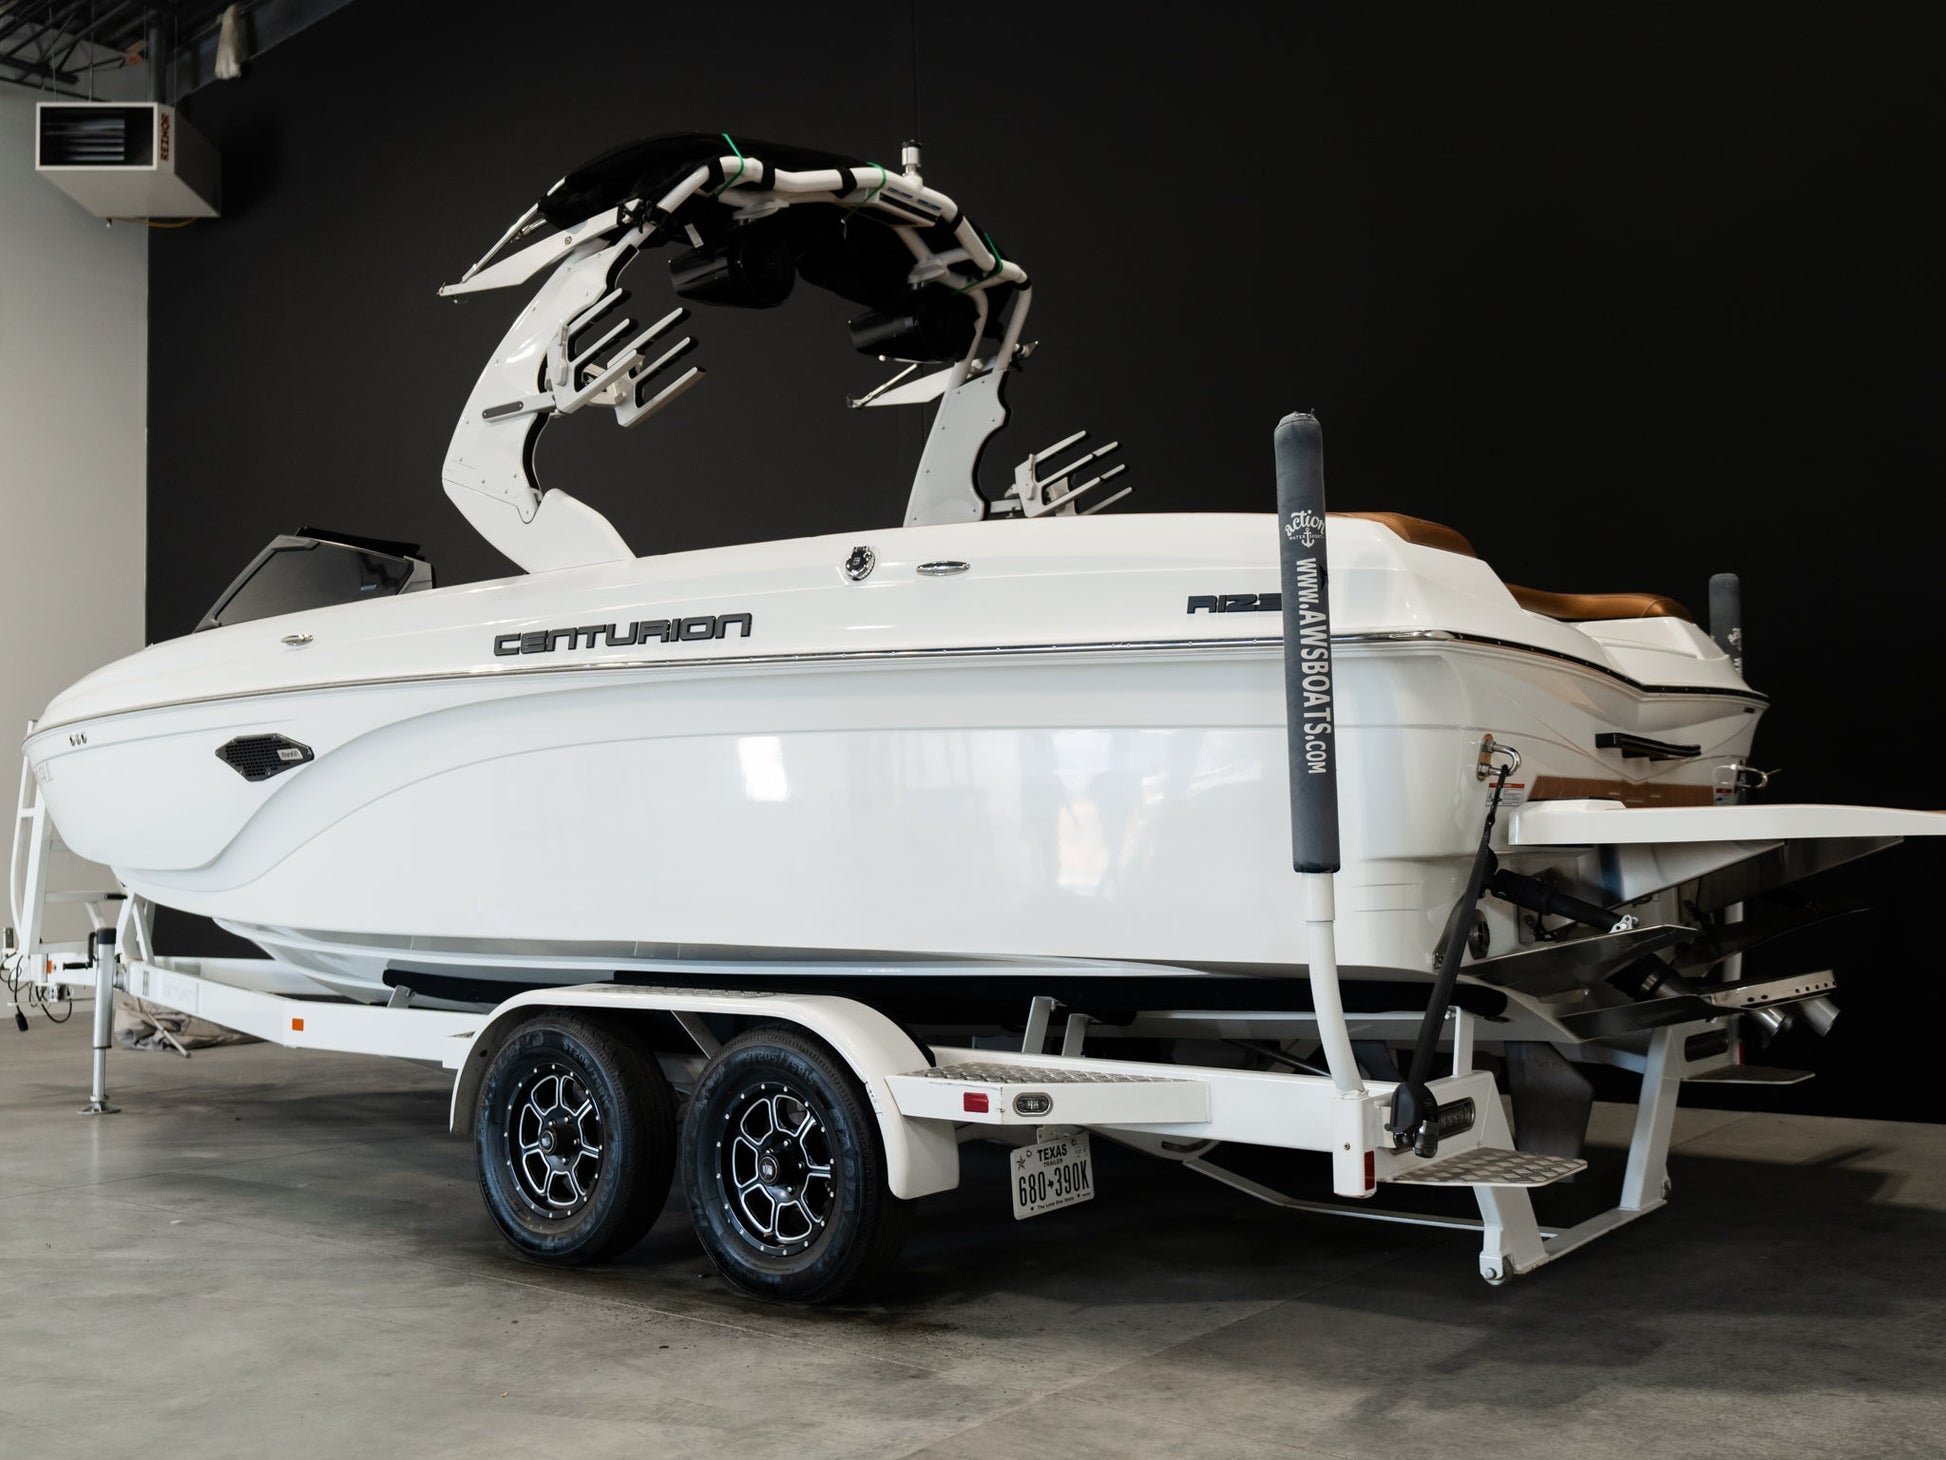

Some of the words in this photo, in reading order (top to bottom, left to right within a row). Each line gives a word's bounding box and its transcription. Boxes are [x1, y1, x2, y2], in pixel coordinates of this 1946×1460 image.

[160, 113, 170, 161] REZNOR
[494, 613, 752, 656] CENTURION
[1296, 557, 1332, 775] WWW.AWSBOATS.COM
[1037, 1143, 1067, 1162] TEXAS
[1043, 1158, 1063, 1168] TRAILER
